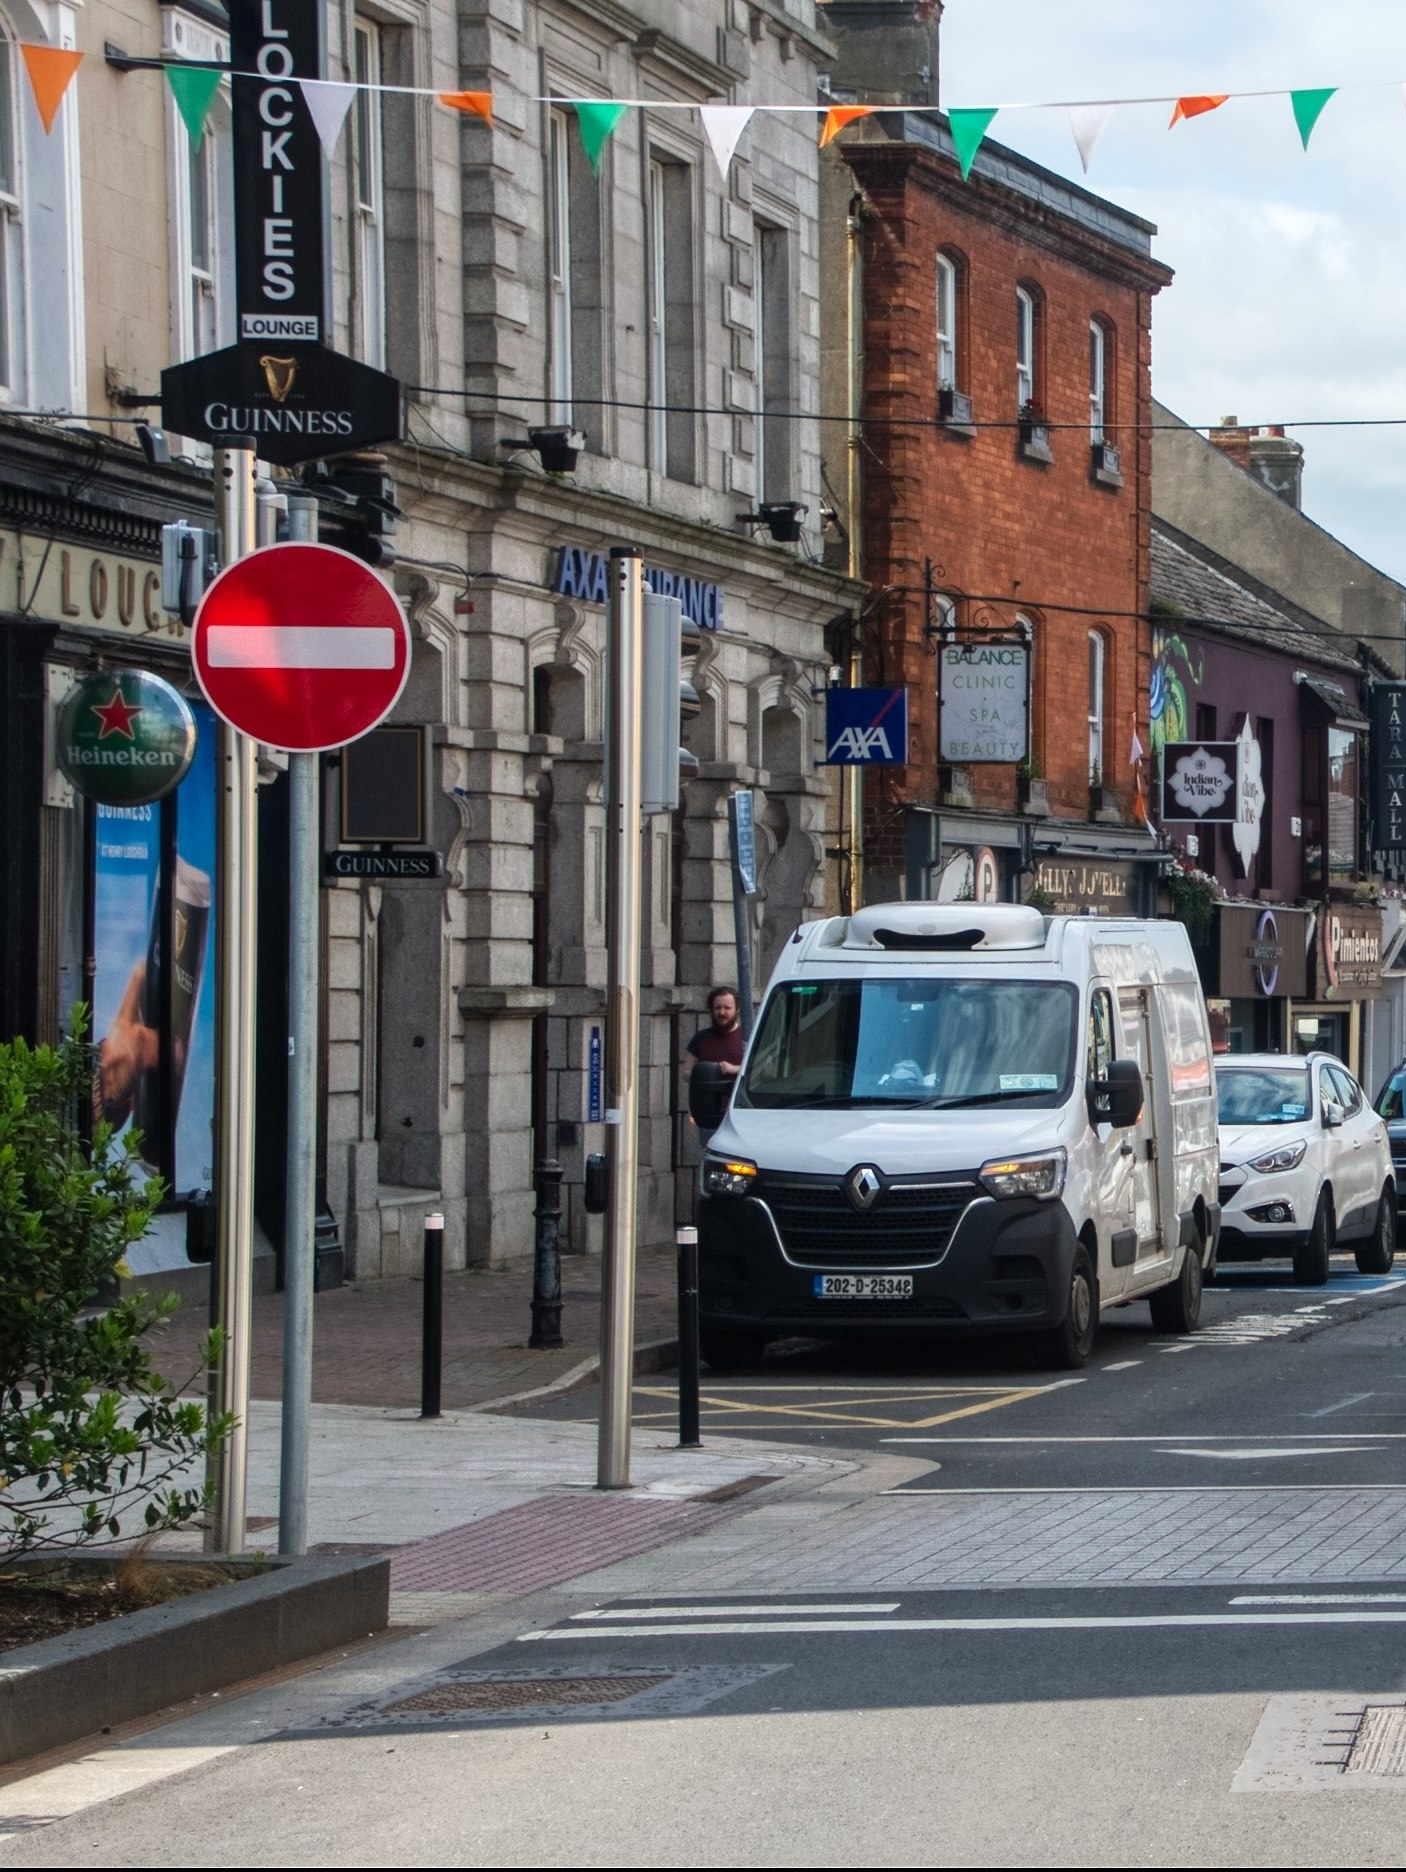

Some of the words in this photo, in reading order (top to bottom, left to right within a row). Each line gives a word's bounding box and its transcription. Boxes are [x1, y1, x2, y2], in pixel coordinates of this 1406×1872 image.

[243, 319, 316, 336] LOUNGE
[204, 402, 353, 435] GUINNESS
[559, 545, 609, 604] AXA
[946, 650, 1023, 665] BALANCE
[952, 675, 1015, 689] CLINIC
[969, 709, 1001, 722] SPA
[1387, 692, 1402, 759] TARA
[828, 727, 893, 759] AXA
[950, 742, 1019, 756] BEAUTY
[67, 746, 176, 766] Heineken
[1184, 773, 1223, 788] Indian
[1184, 784, 1217, 797] Vibe
[1387, 774, 1404, 841] MALL
[335, 854, 430, 874] GUINNESS
[1331, 916, 1379, 962] Pimientos
[826, 1278, 911, 1294] 202-D-25348
